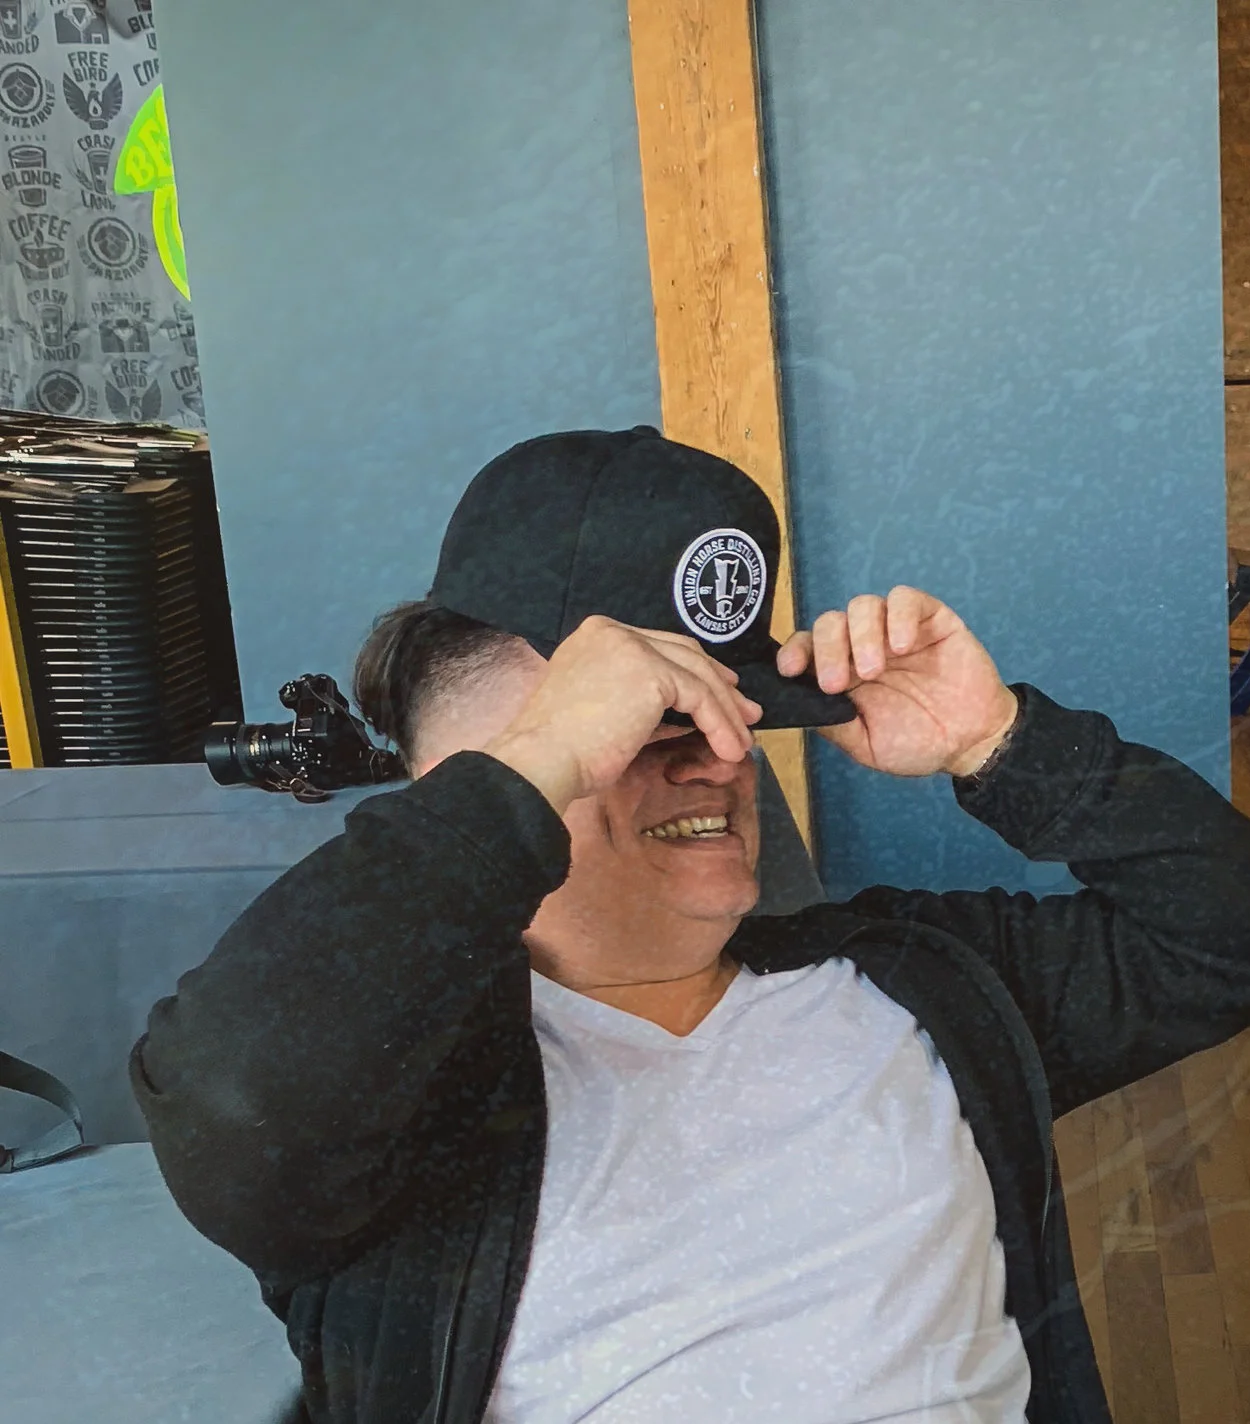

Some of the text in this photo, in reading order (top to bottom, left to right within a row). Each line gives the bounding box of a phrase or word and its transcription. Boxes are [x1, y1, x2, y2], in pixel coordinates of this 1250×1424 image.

[68, 51, 109, 68] FREE
[73, 68, 108, 82] BIRD
[2, 170, 62, 190] BLONDE
[8, 213, 72, 242] COFFEE
[684, 567, 699, 607] UNION
[692, 539, 725, 568] HORSE
[727, 538, 761, 586] DISTILLING
[694, 611, 748, 632] KANSAS CITY
